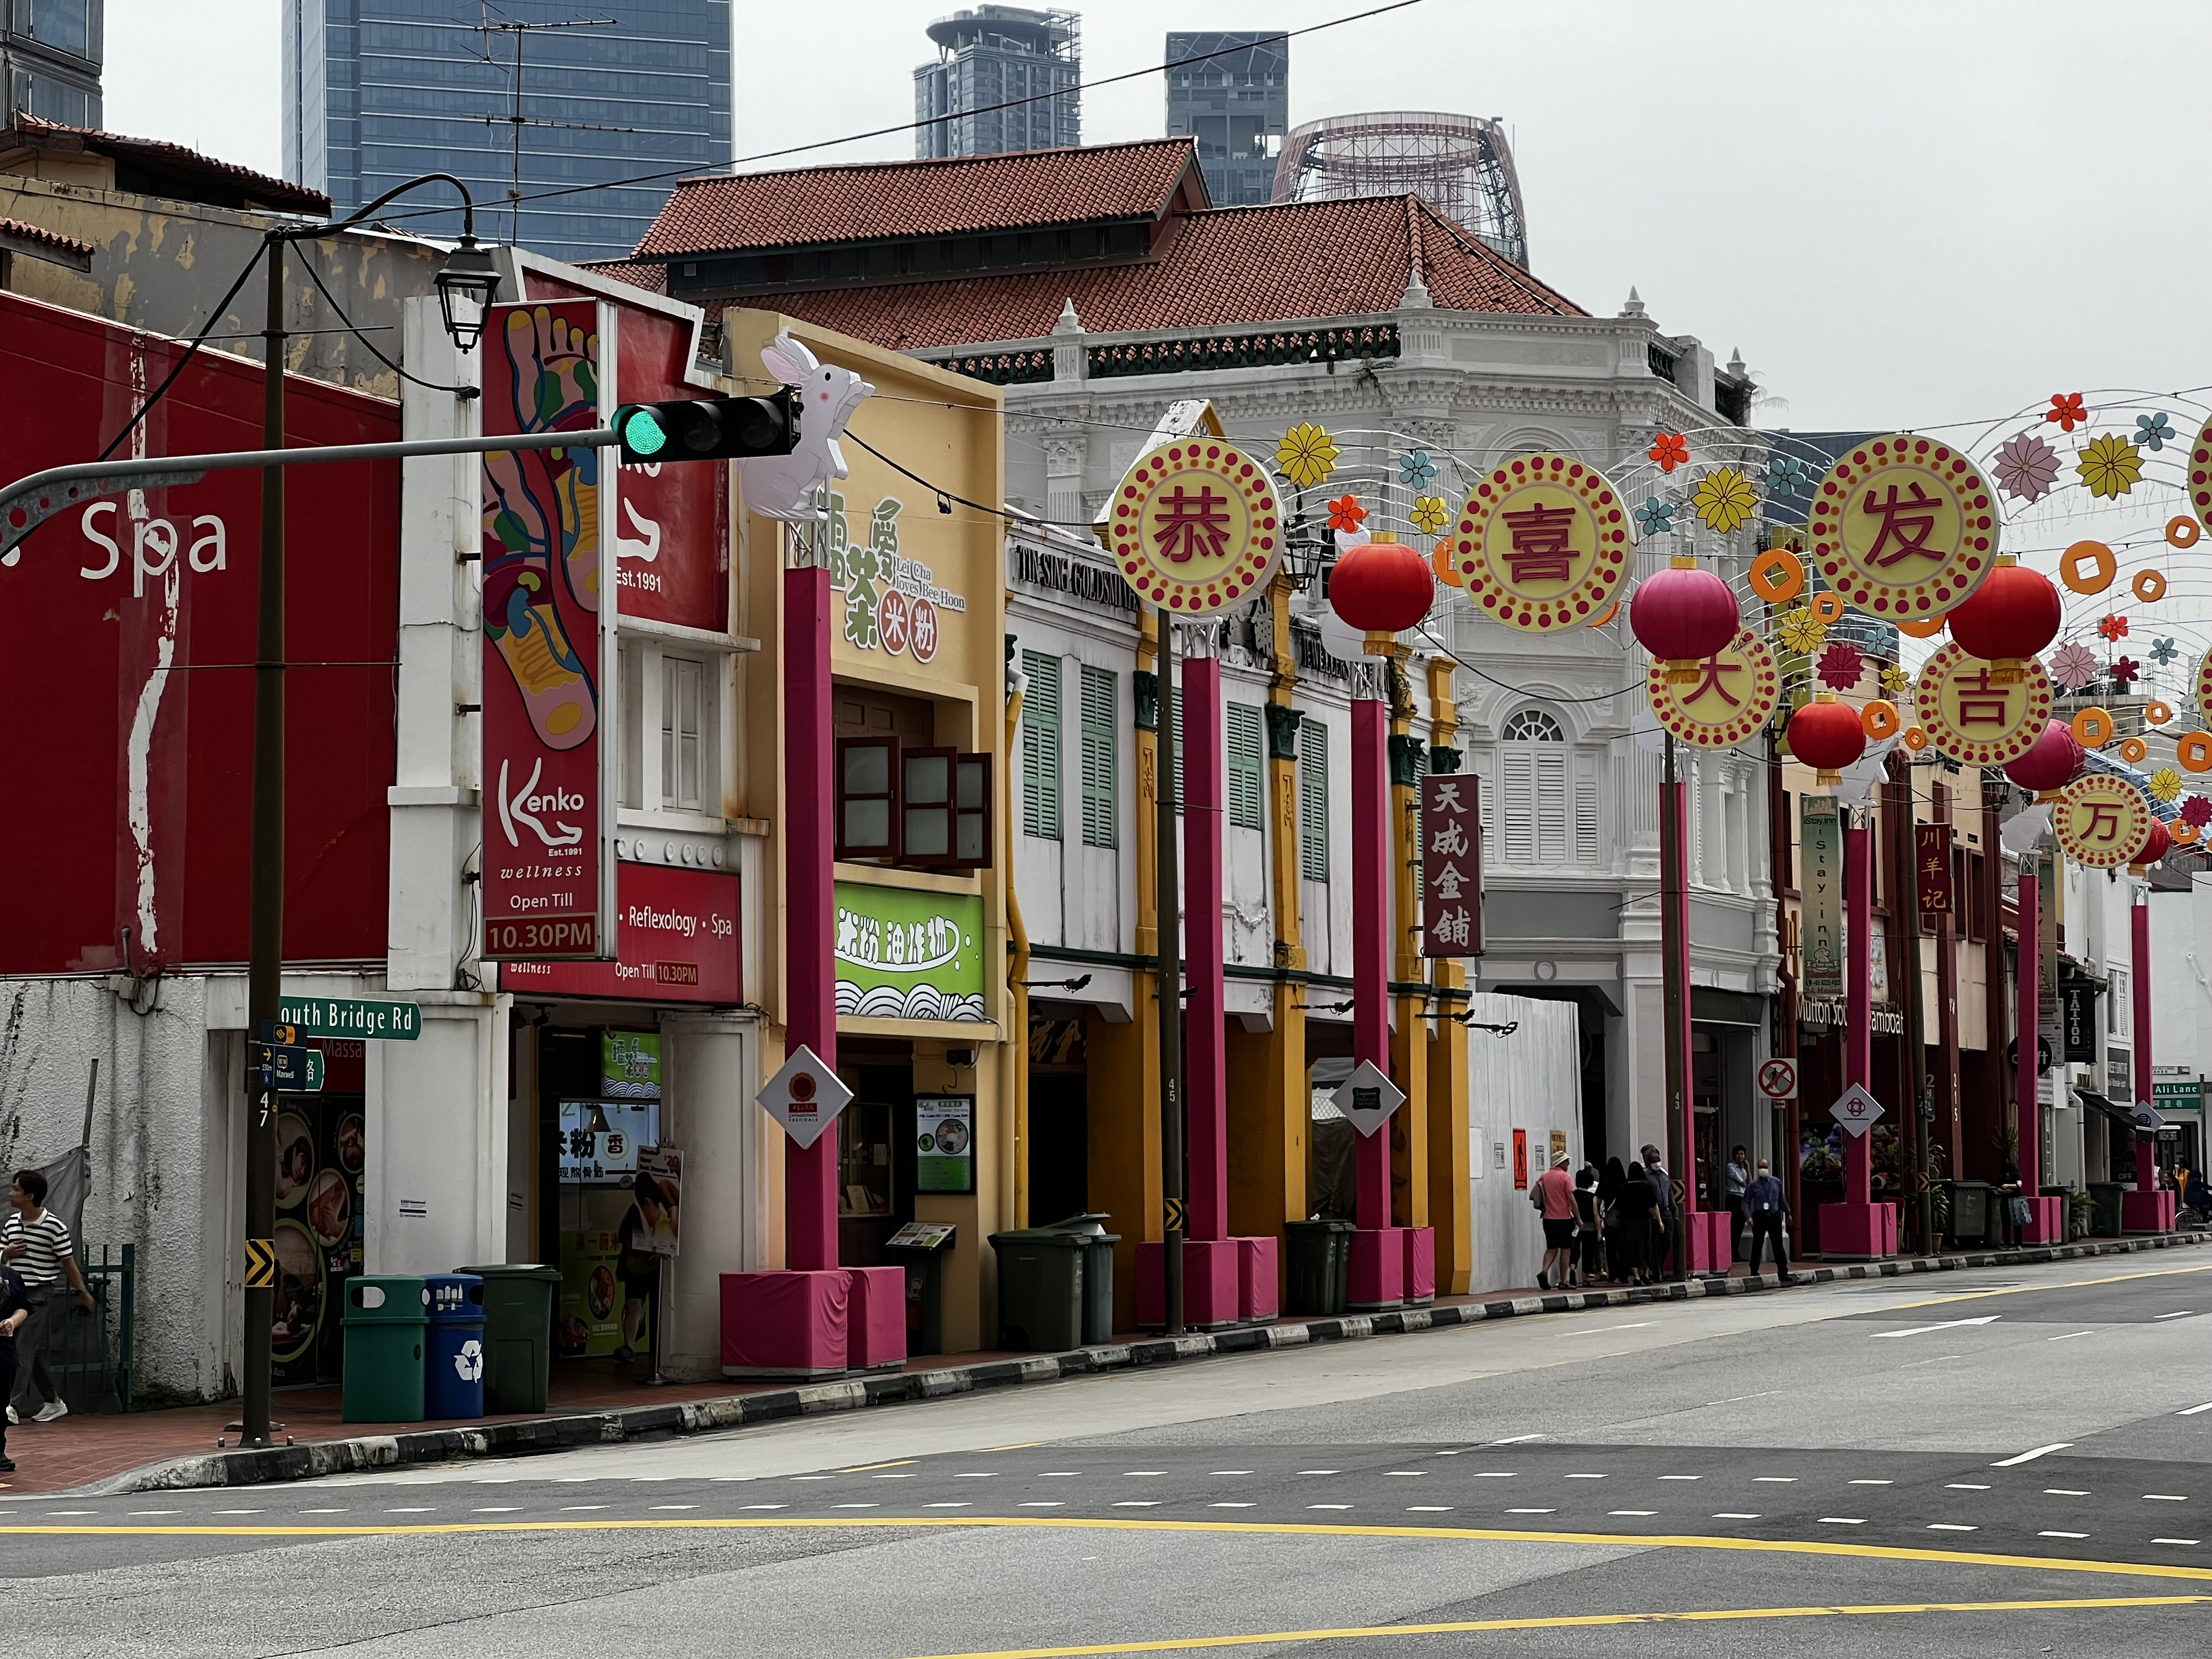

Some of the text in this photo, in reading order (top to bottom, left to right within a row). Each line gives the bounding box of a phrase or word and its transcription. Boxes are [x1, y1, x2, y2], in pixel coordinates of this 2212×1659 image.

[1154, 486, 1230, 562] 恭
[1863, 481, 1947, 567] 发
[80, 502, 226, 598] Spa
[1501, 503, 1580, 583] 喜
[616, 566, 662, 593] Est.1991
[896, 557, 931, 581] Lei Cha
[1018, 545, 1040, 584] TIN
[1040, 553, 1068, 592] SING
[895, 575, 965, 609] loves Bee Hoon
[884, 597, 935, 653] 米粉
[1682, 655, 1742, 707] 大
[1953, 667, 2010, 727] 吉
[498, 757, 585, 847] Kenko
[1803, 817, 1836, 825] iStay.inn
[2079, 802, 2124, 841] 万
[548, 848, 582, 857] Est.1991
[500, 865, 582, 879] wellness
[1921, 831, 1947, 909] 川羊记
[510, 892, 573, 911] Open Till
[490, 922, 591, 949] 10.30PM
[629, 906, 732, 940] Reflexology Spa
[510, 963, 551, 975] wellness
[615, 962, 697, 983] Open Till 10.30PM
[329, 1003, 385, 1035] Bridge
[393, 1006, 413, 1031] Rd
[1797, 994, 1830, 1024] Mutton
[2069, 989, 2080, 1045] TATTOO
[322, 1039, 366, 1060] Massa
[276, 1070, 294, 1079] Maxwell
[1168, 1078, 1176, 1102] 45
[2155, 1084, 2169, 1093] Ali
[260, 1092, 269, 1127] 47
[1674, 1092, 1680, 1110] 43
[607, 1134, 624, 1154] 香
